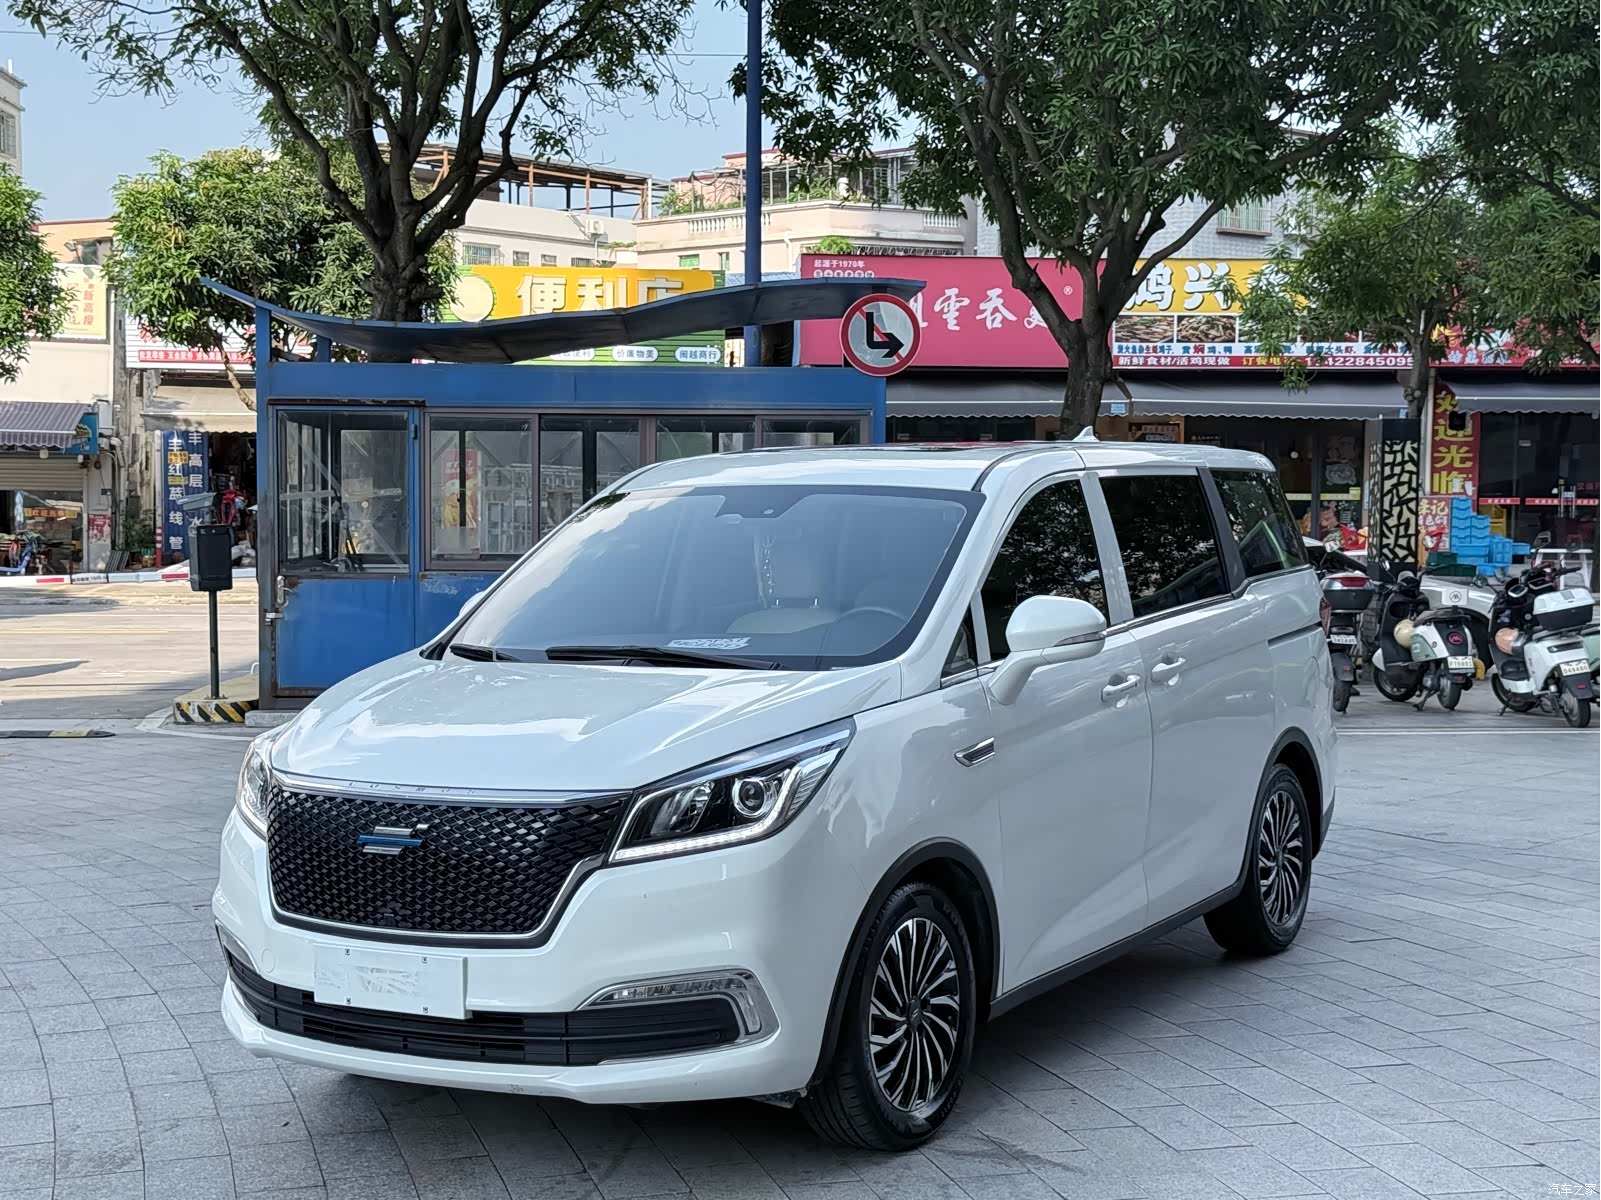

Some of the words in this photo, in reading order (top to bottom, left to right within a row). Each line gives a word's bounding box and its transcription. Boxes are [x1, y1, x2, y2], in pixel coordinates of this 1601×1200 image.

[814, 259, 865, 268] 起源于1970年
[1118, 356, 1230, 366] 新鲜食材/活鸡现做
